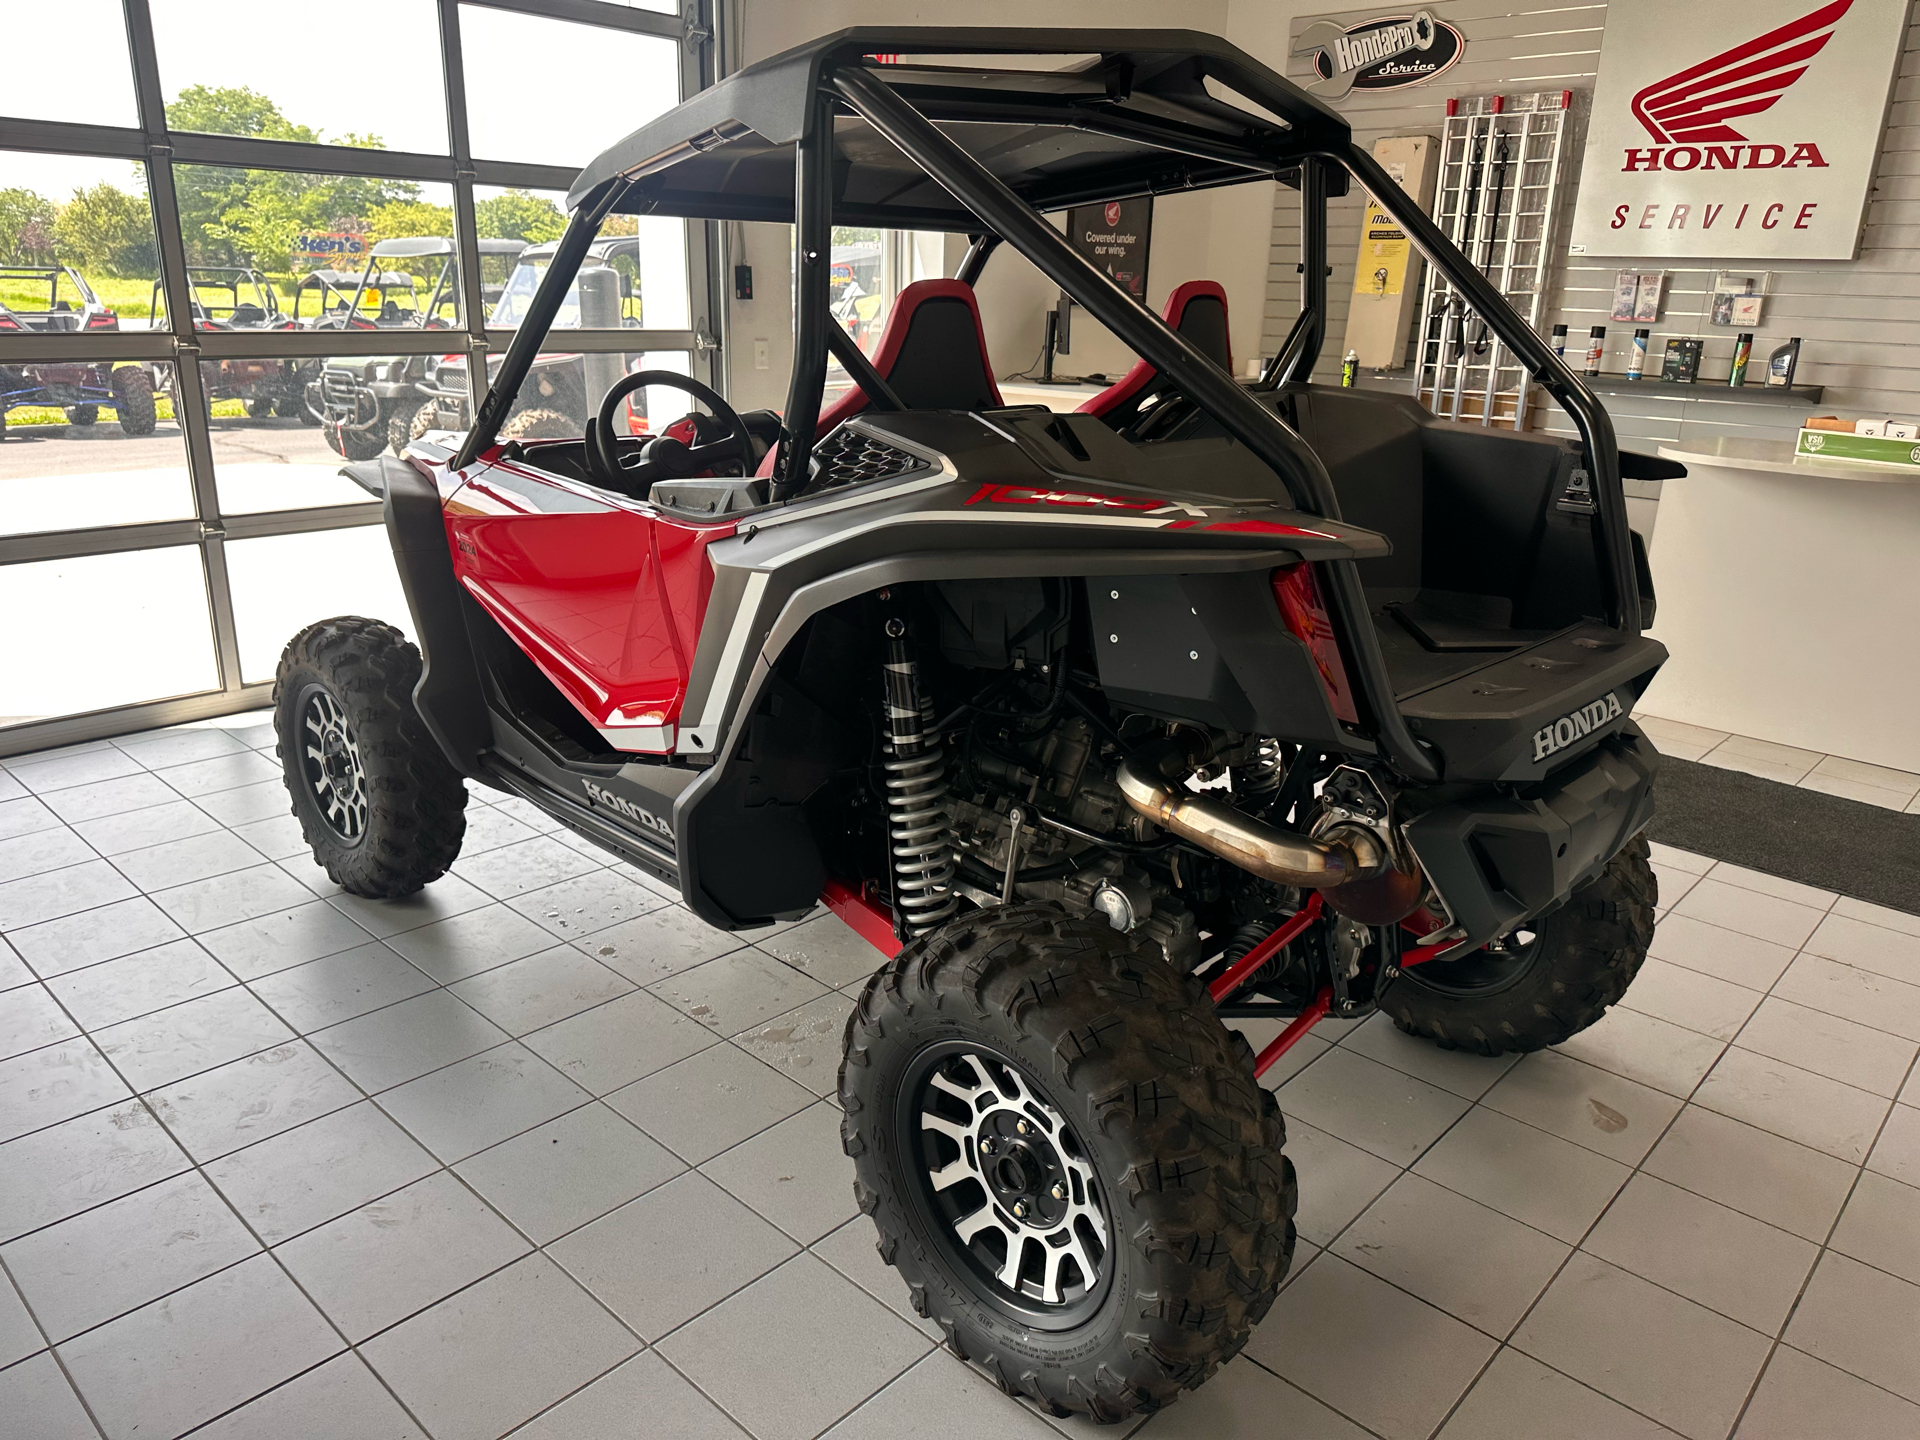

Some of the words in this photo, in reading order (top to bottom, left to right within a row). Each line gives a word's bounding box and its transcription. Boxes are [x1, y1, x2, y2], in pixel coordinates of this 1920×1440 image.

[1334, 26, 1414, 73] HondaPro
[1379, 60, 1437, 75] Service
[1621, 143, 1829, 172] HONDA
[1610, 203, 1818, 230] SERVICE
[1085, 231, 1116, 243] Covered
[1116, 233, 1137, 244] under
[1094, 245, 1107, 255] our
[1108, 244, 1126, 258] wing.
[1807, 434, 1824, 447] USA
[1533, 691, 1623, 762] HONDA
[581, 778, 676, 840] HONDA
